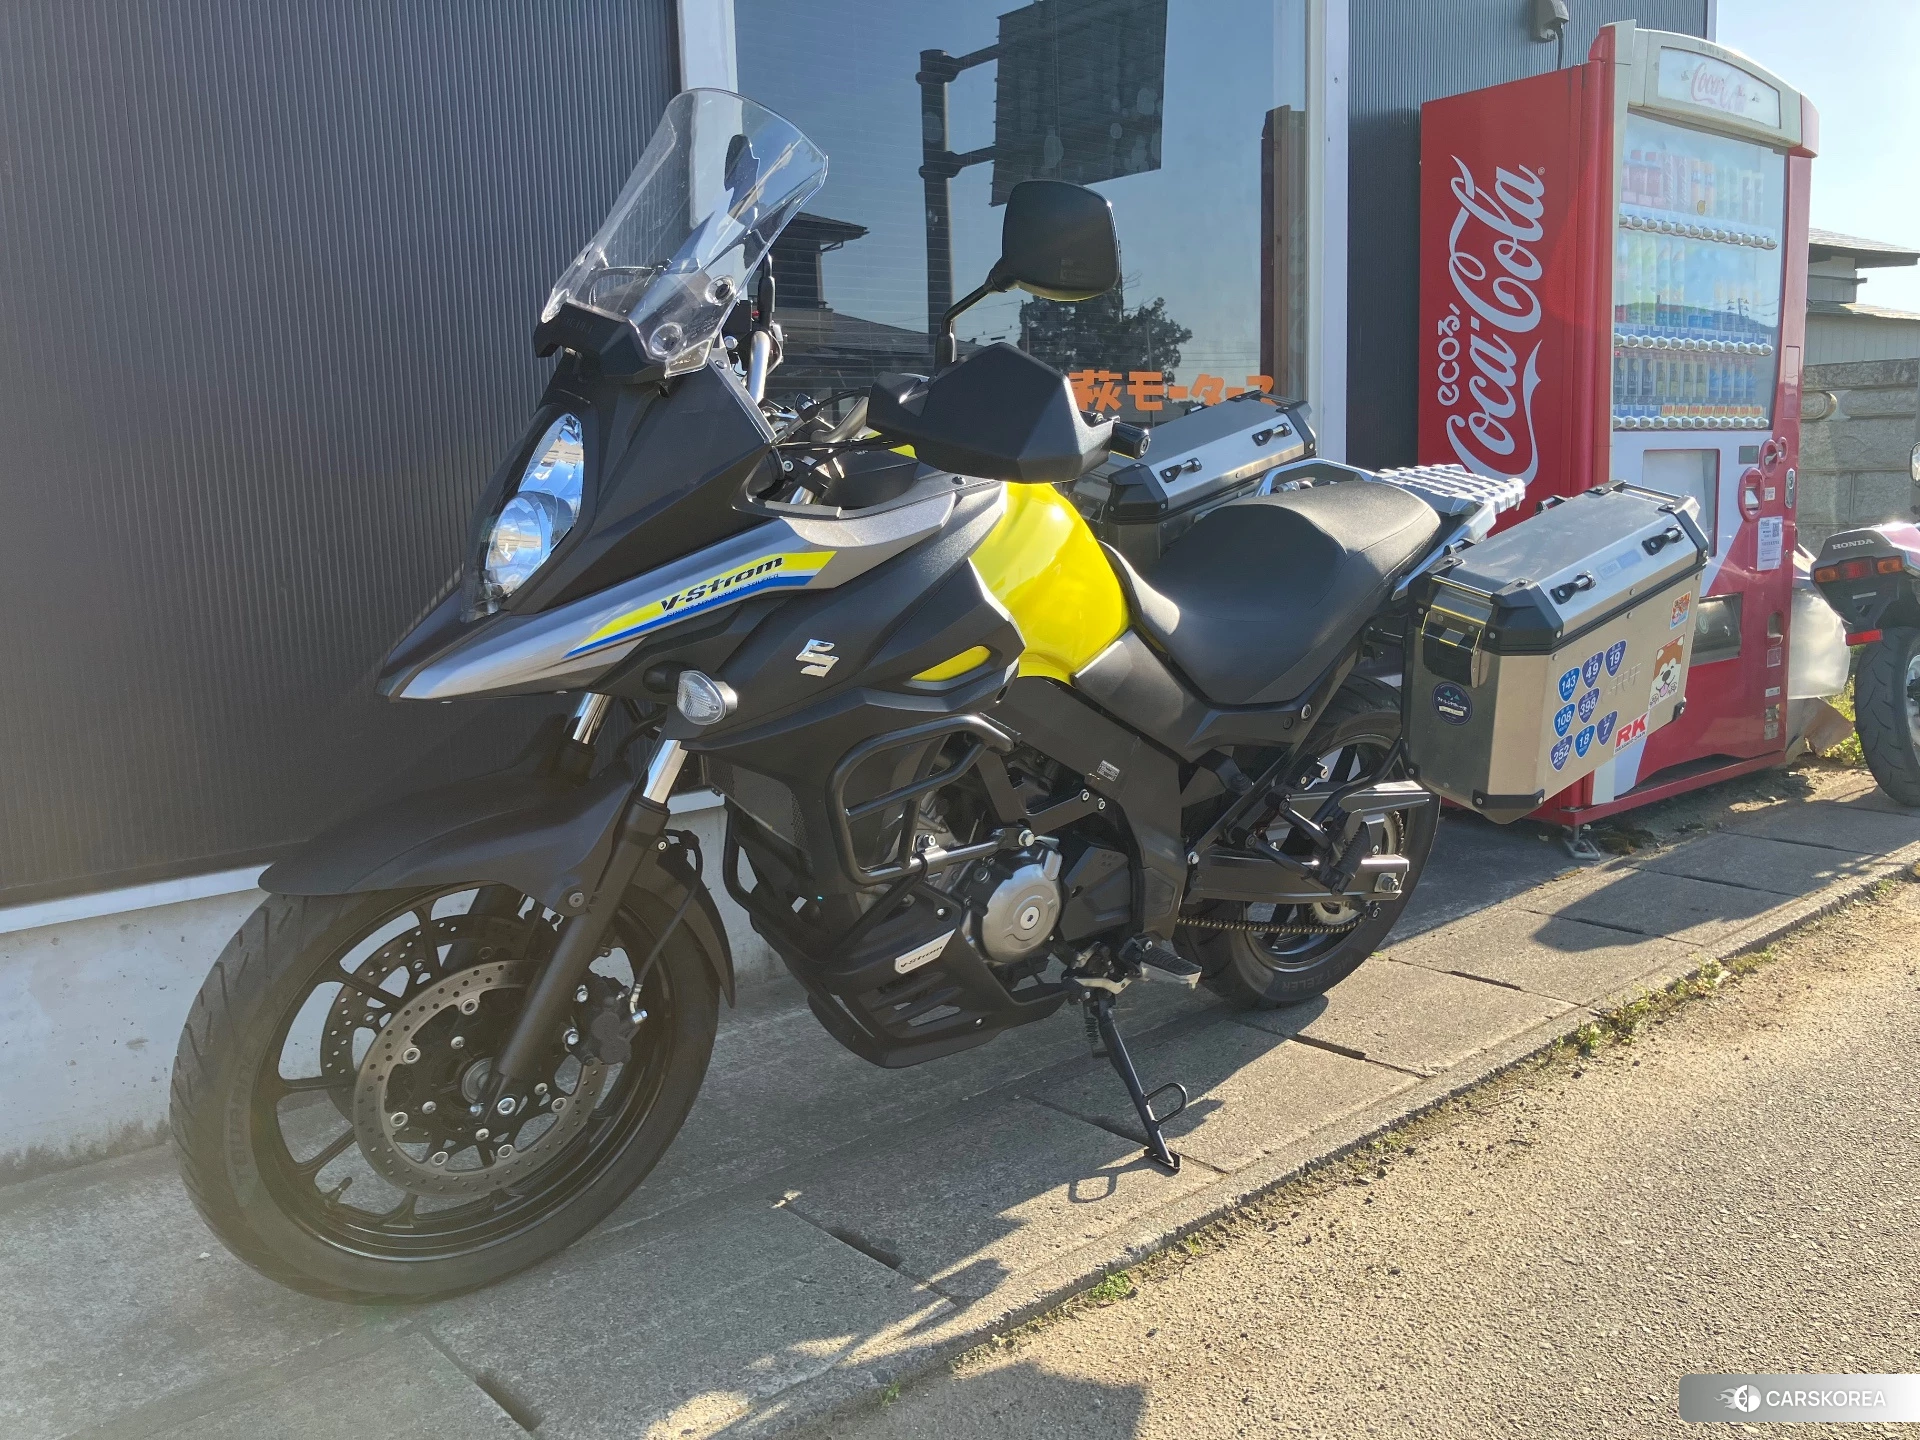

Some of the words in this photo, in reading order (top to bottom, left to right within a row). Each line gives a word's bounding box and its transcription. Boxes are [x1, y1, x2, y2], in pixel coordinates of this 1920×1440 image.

[1446, 154, 1545, 487] Coca-Cola
[1832, 538, 1874, 550] HONDA
[660, 557, 783, 612] V-Strom
[1610, 652, 1620, 666] 19
[1586, 663, 1598, 678] 49
[1562, 676, 1576, 692] 143
[1580, 697, 1597, 715] 398
[1557, 711, 1572, 727] 108
[1603, 723, 1610, 735] 7
[1615, 712, 1648, 748] RK
[1580, 734, 1590, 747] 18
[1554, 745, 1570, 763] 252
[226, 1040, 256, 1186] TOURANC
